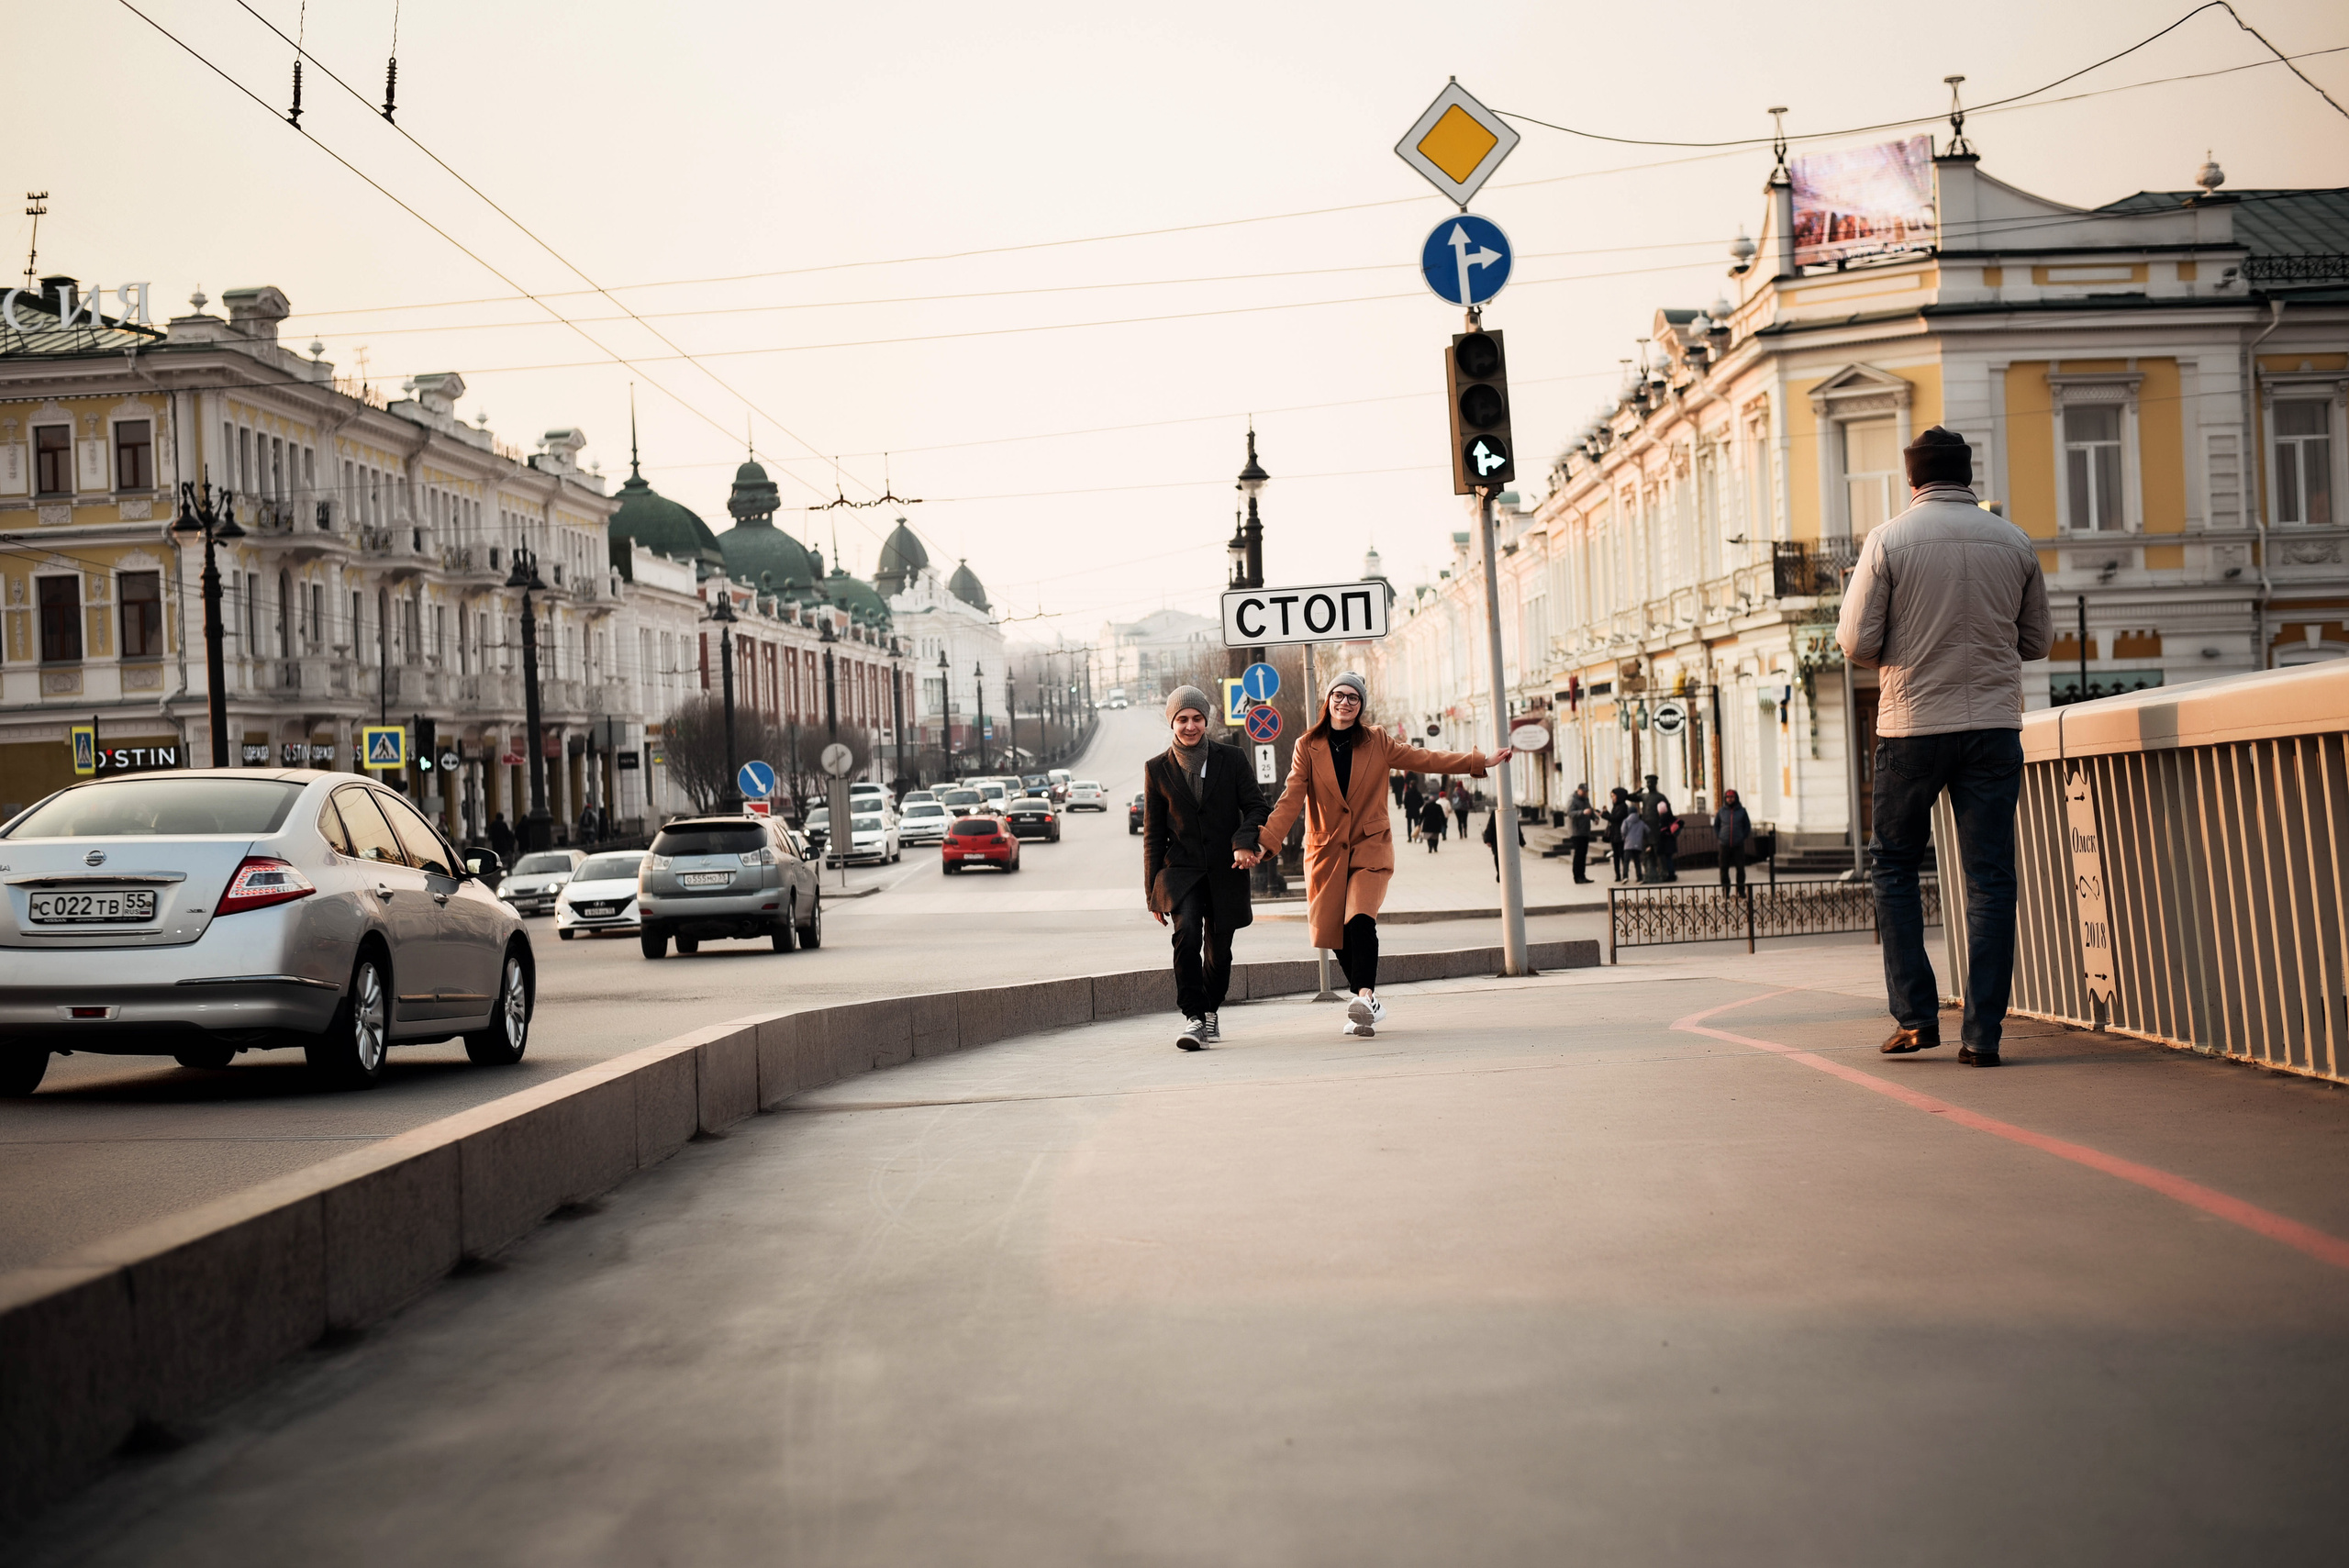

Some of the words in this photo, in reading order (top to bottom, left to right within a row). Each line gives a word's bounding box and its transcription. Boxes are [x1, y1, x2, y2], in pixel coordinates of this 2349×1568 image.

[3, 283, 151, 331] СИЯ
[1236, 591, 1373, 639] СТОП
[2072, 827, 2097, 853] Омск
[127, 894, 146, 908] 55
[2084, 920, 2107, 949] 2018
